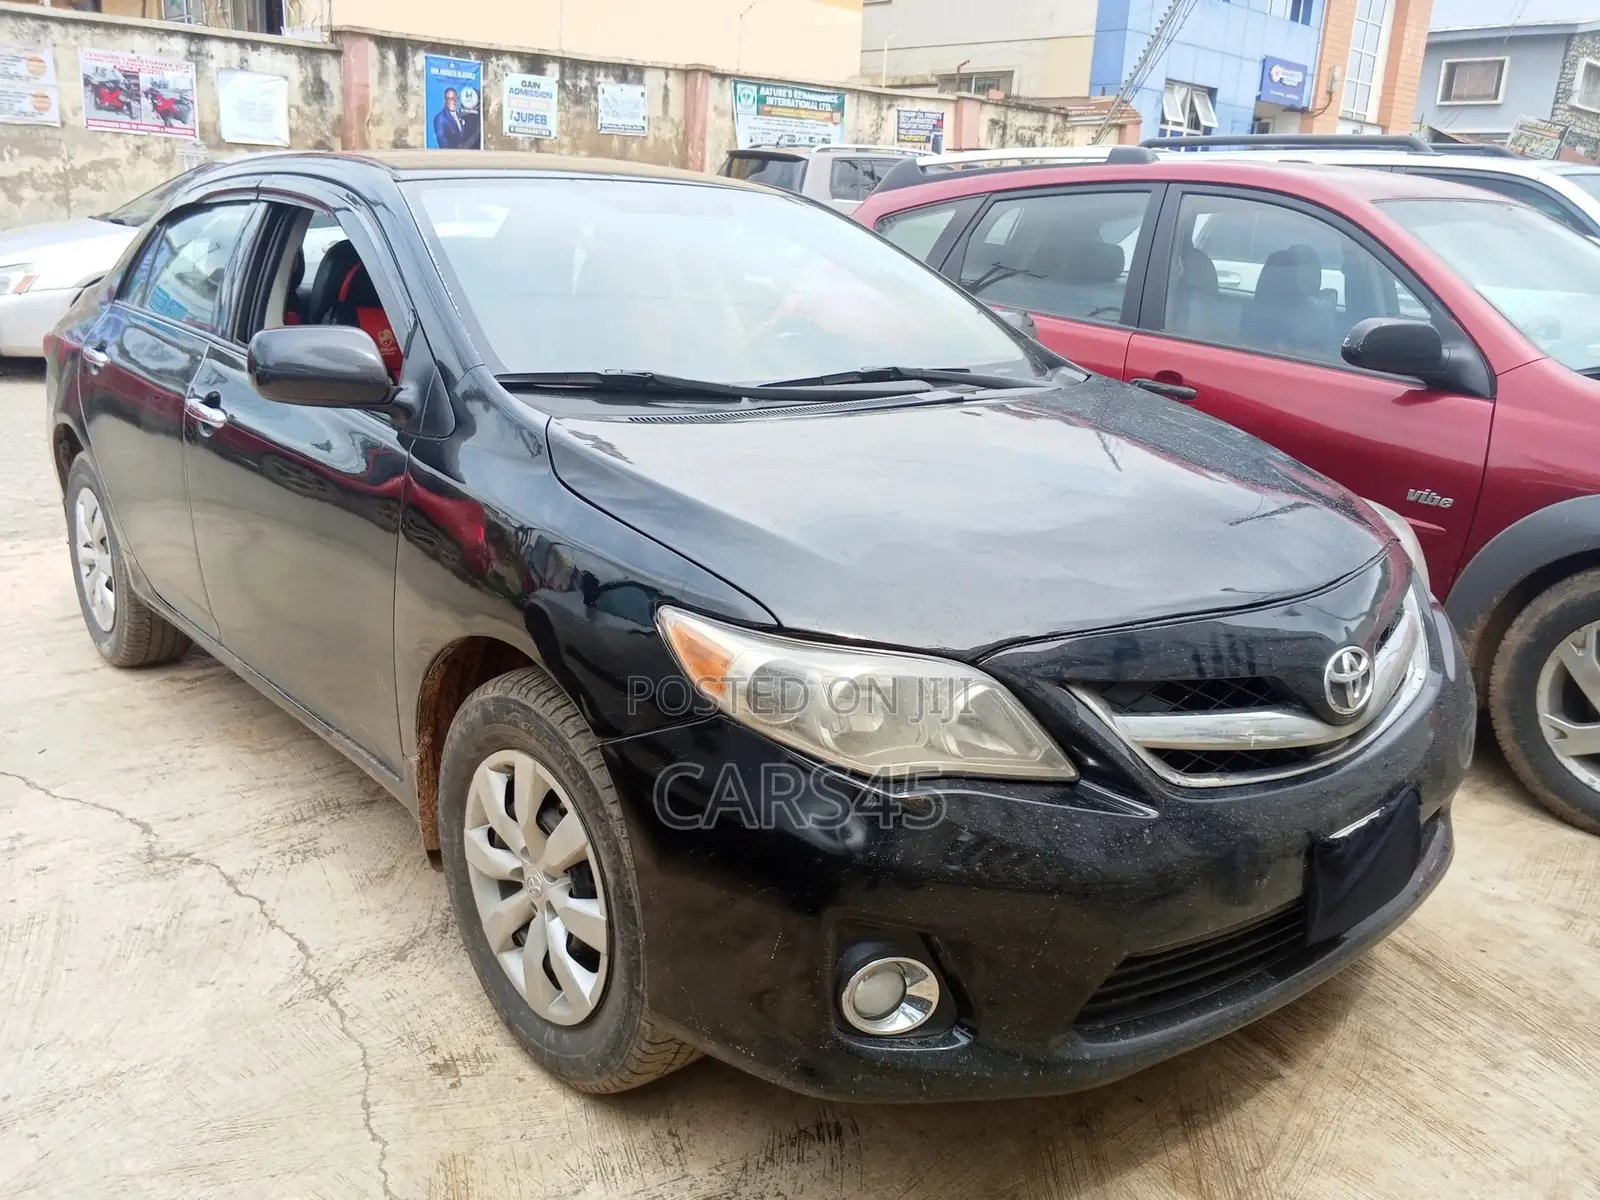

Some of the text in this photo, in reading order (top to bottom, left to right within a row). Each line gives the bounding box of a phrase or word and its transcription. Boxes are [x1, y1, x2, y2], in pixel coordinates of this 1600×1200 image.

[521, 80, 541, 89] GAIN
[508, 87, 552, 99] ADMISSION
[766, 96, 819, 110] INTERNATIONAL
[514, 112, 547, 125] JUPEB
[1406, 488, 1455, 508] vibe
